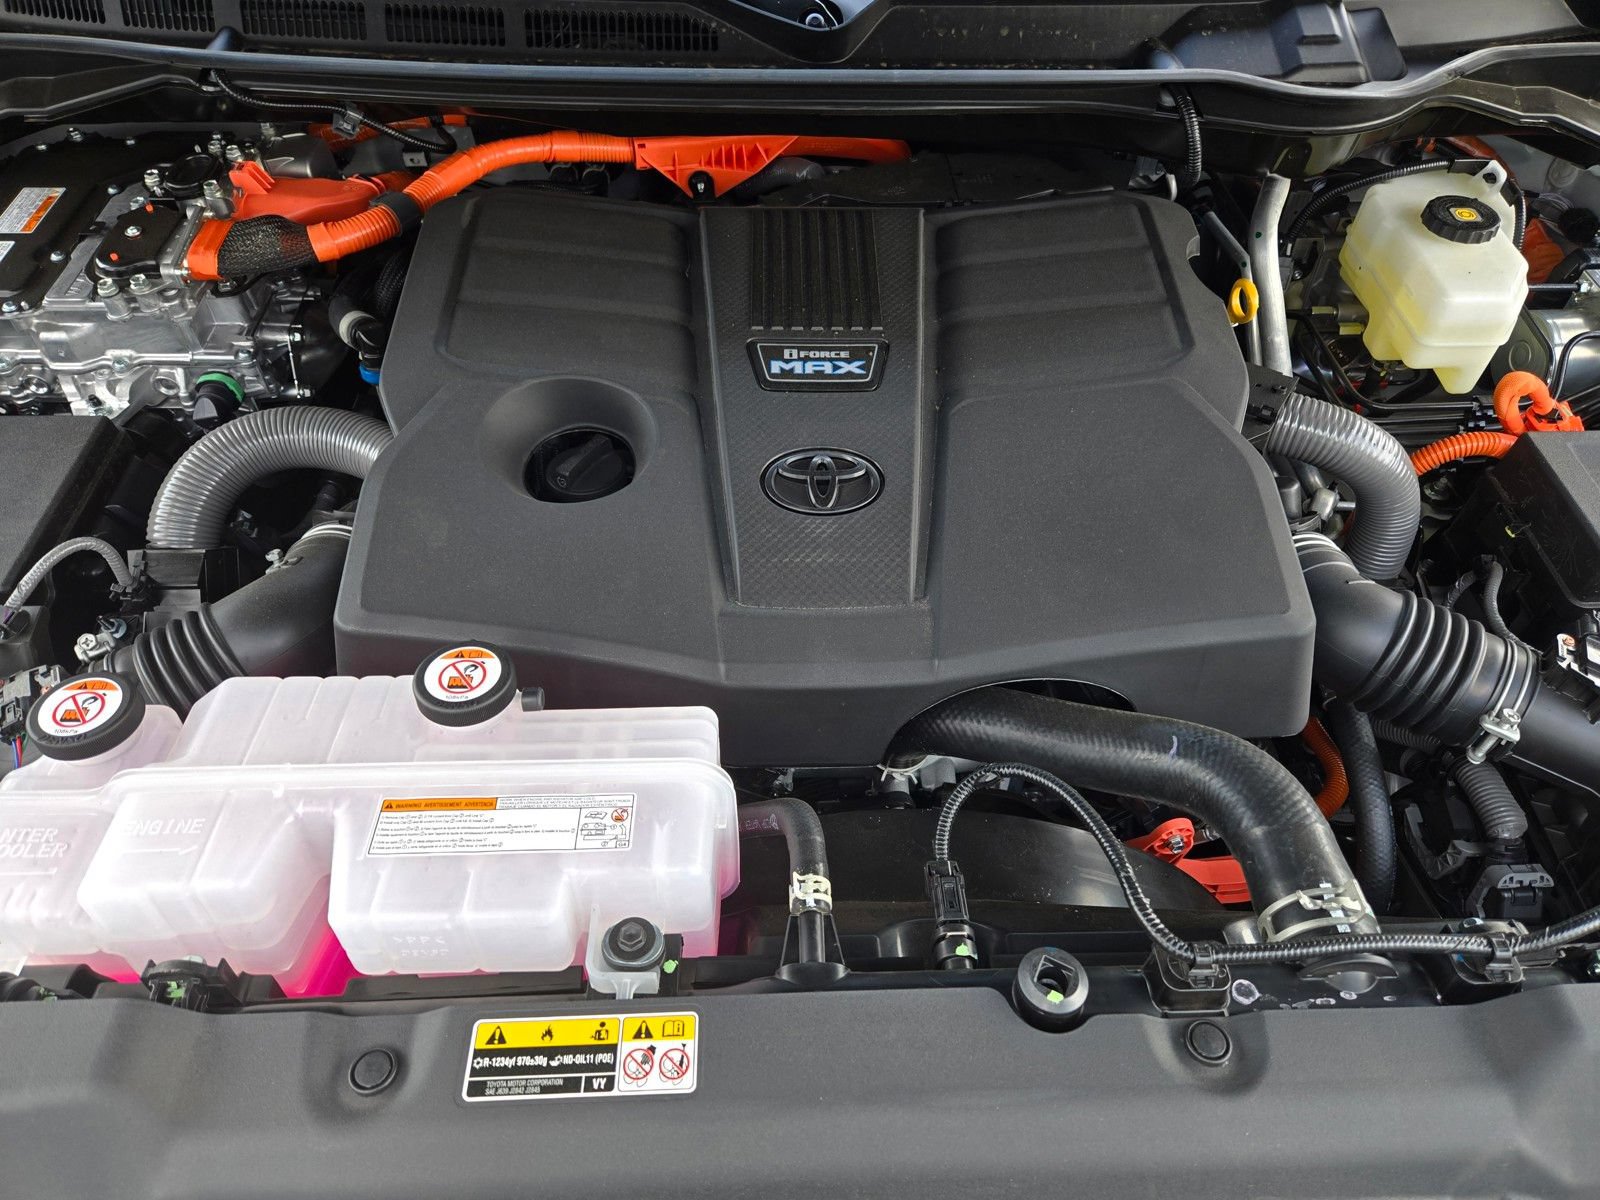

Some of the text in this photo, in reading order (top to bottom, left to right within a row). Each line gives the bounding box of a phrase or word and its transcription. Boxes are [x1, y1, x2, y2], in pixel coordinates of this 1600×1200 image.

[799, 350, 850, 358] FORCE
[770, 360, 867, 375] MAX
[121, 818, 206, 837] ENGINE
[483, 1057, 516, 1067] R-1234yf
[595, 1052, 614, 1064] (POE)
[526, 1078, 563, 1086] CORPORATION
[593, 1078, 607, 1090] VY
